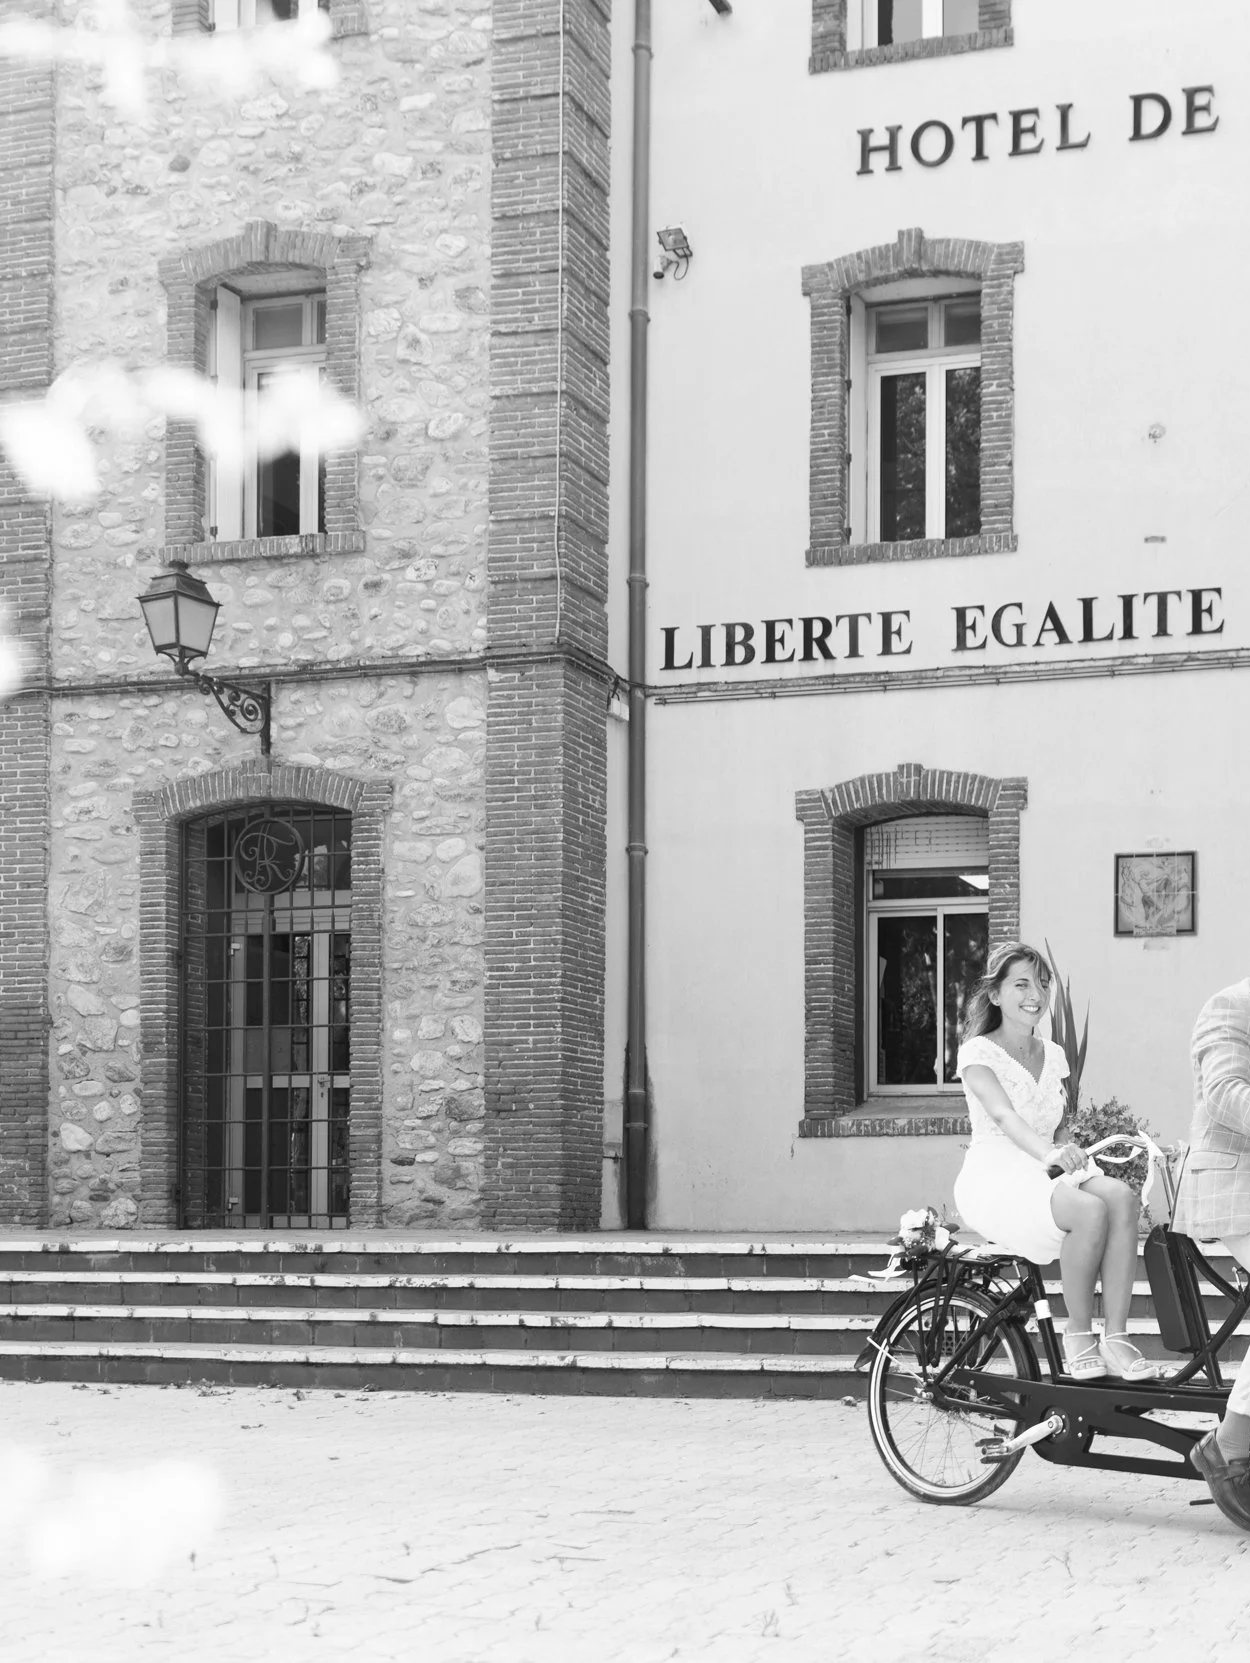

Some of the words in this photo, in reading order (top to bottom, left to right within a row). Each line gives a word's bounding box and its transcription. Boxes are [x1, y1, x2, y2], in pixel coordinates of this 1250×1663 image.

[856, 103, 1091, 176] HOTEL
[1128, 85, 1220, 142] DE
[659, 610, 913, 671] LIBERTE
[951, 587, 1225, 652] EGALITE
